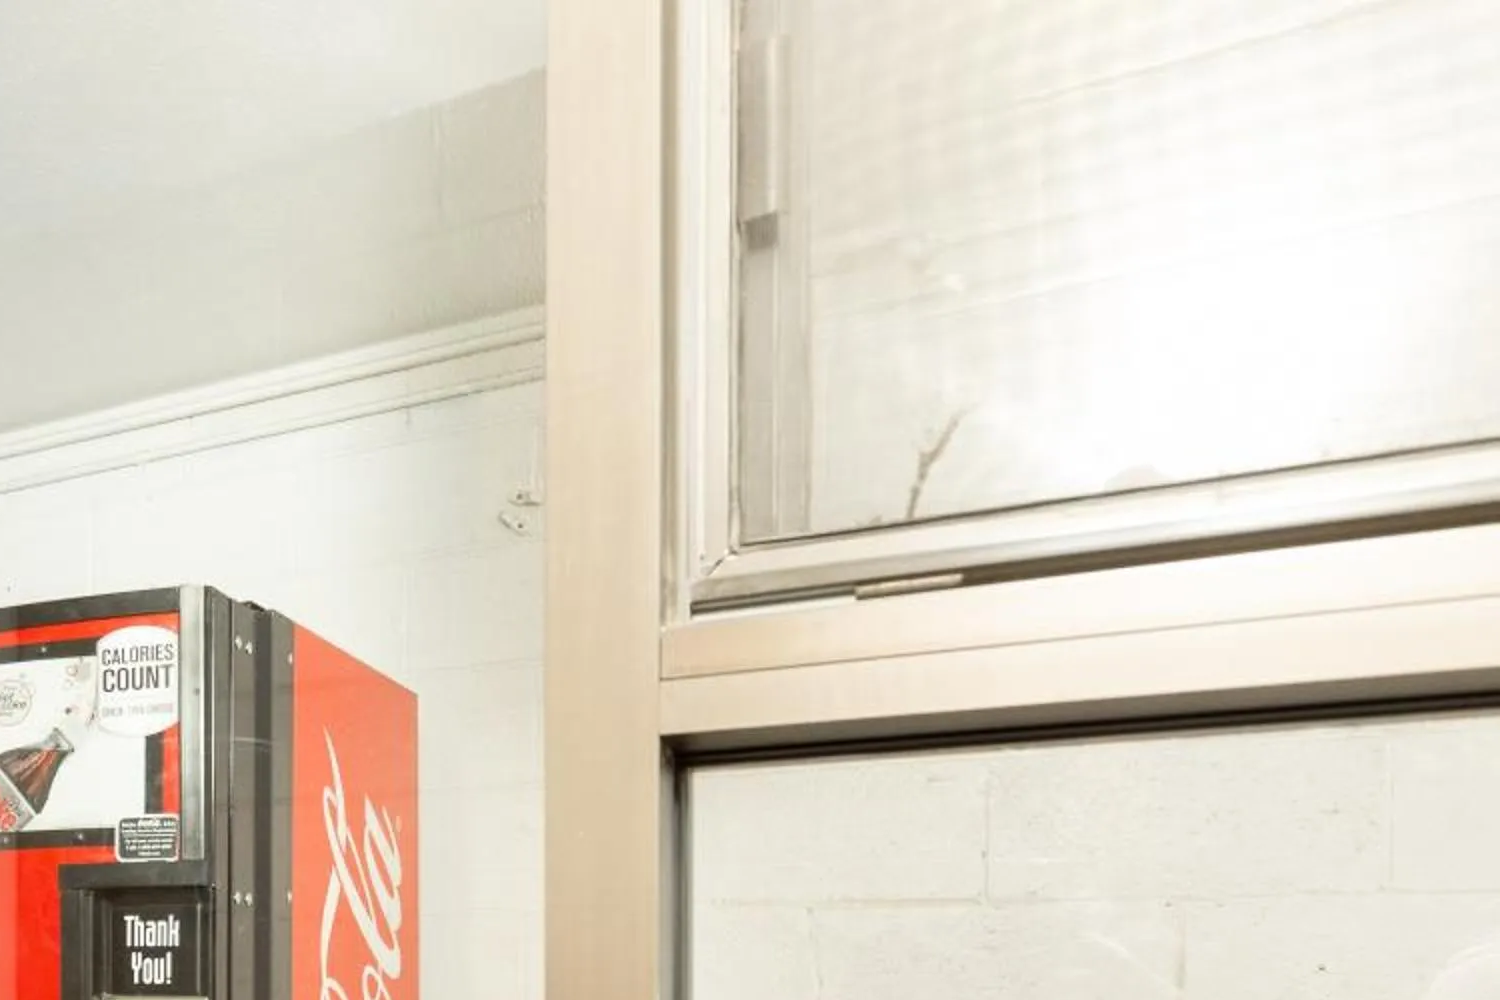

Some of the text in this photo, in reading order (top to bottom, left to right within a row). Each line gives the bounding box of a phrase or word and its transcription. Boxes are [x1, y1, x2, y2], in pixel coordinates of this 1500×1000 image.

[101, 643, 174, 666] CALORIES
[102, 664, 174, 693] COUNT
[123, 913, 181, 948] Thank
[130, 951, 173, 985] You!
